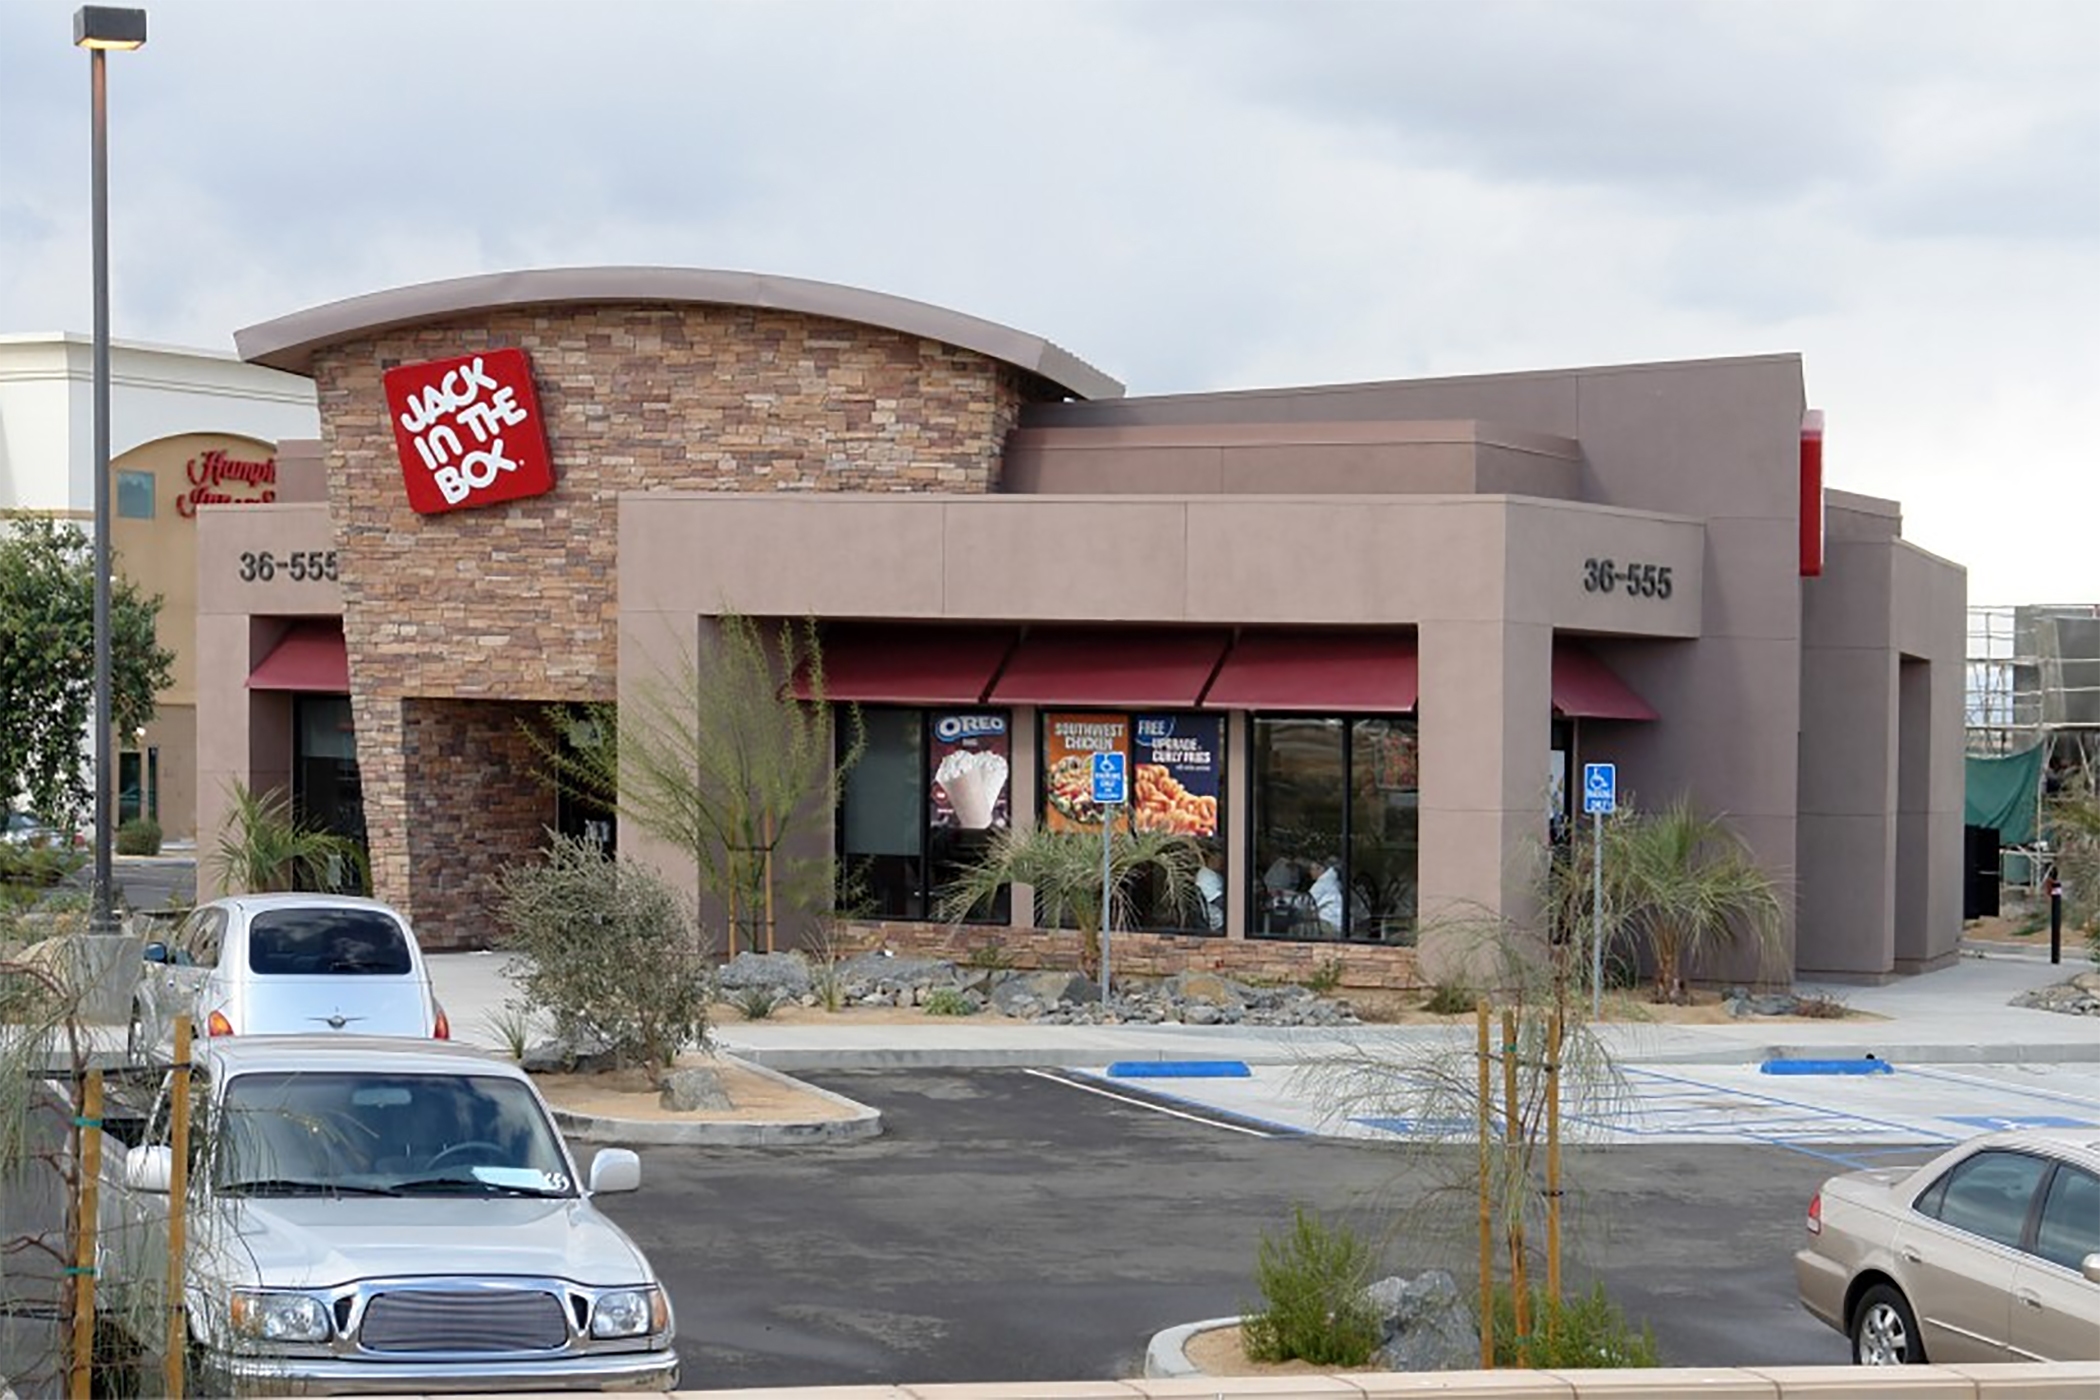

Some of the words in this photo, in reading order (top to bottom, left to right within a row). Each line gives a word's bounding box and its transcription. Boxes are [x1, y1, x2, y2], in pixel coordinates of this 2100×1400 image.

[401, 357, 497, 432] JACK
[414, 425, 463, 470] IN
[456, 386, 527, 442] THE
[434, 438, 517, 504] BOX
[240, 551, 338, 582] 36-555
[1584, 558, 1672, 600] 36-555
[939, 716, 1004, 737] OREO
[1055, 723, 1124, 737] SOUTHWEST
[1138, 720, 1165, 736] FREE
[1065, 737, 1113, 750] CHICKEN
[1152, 751, 1182, 762] CURLY
[1183, 752, 1211, 764] FRIES
